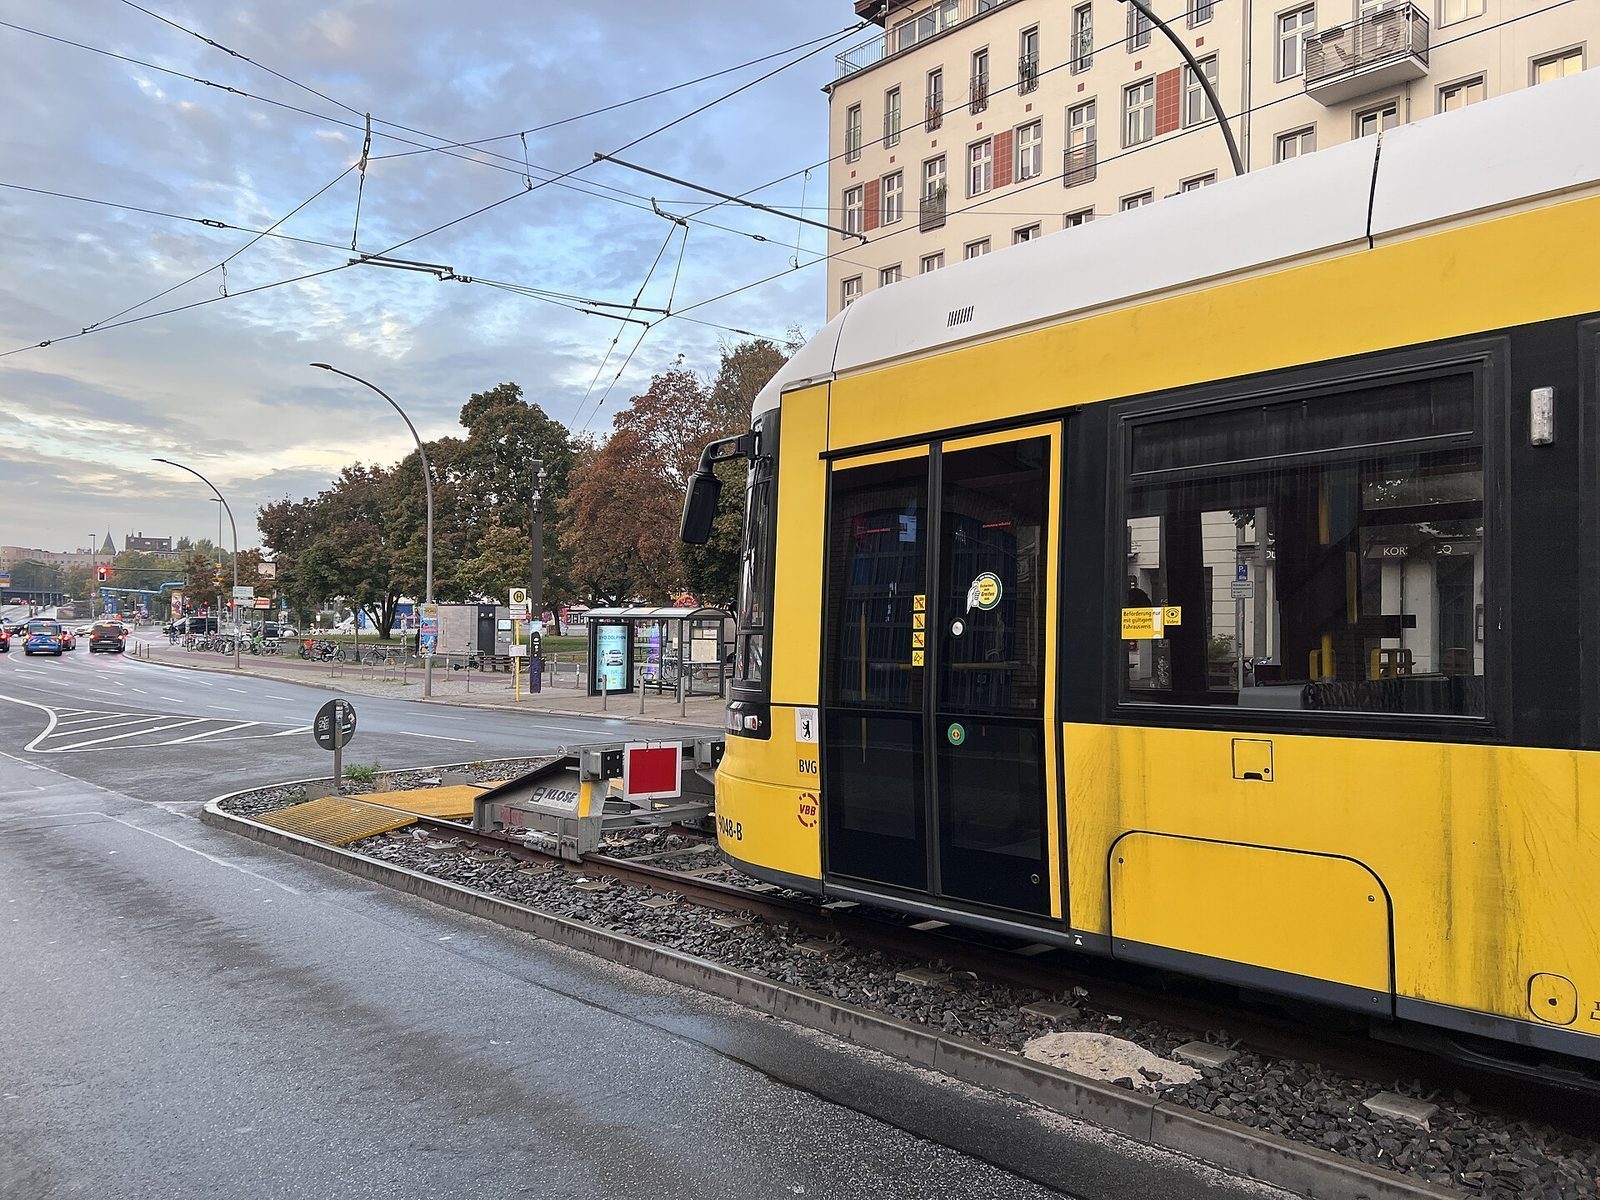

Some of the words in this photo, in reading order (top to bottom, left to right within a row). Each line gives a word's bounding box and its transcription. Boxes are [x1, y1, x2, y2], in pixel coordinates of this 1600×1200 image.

[799, 759, 817, 774] BVG
[545, 789, 577, 803] KLOSE
[799, 803, 816, 816] VBB
